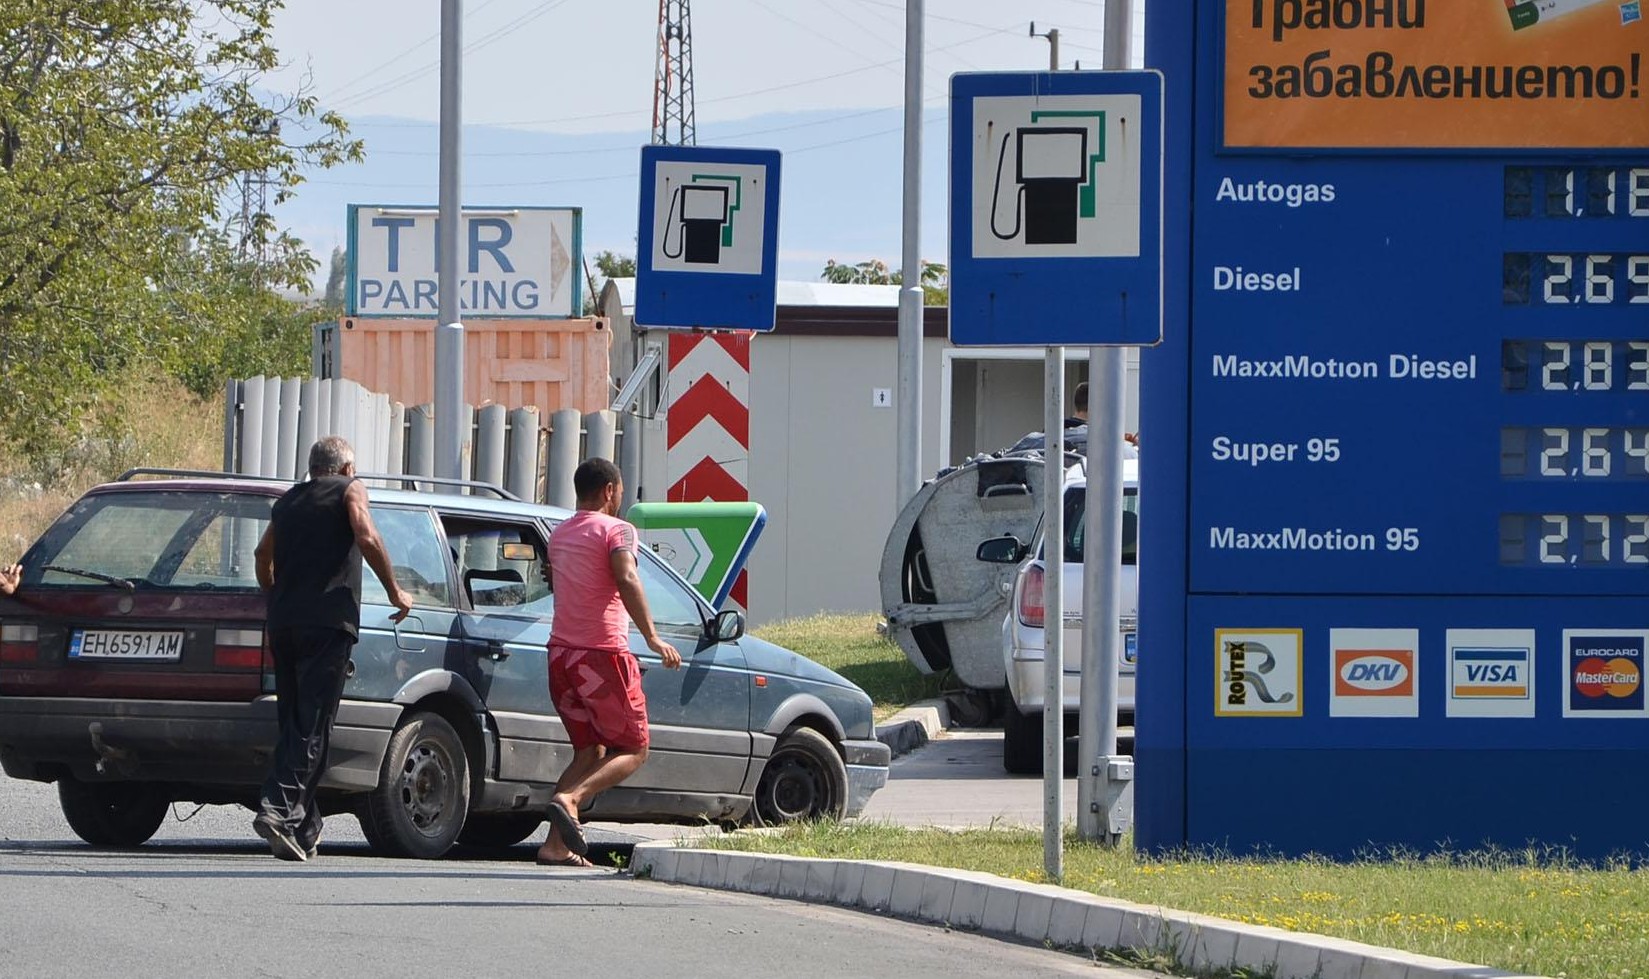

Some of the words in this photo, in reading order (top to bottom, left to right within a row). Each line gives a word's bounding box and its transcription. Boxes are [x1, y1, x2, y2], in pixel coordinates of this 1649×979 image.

[1248, 49, 1640, 99] забавлението!
[1216, 178, 1336, 207] Autogas
[1213, 267, 1300, 291] Diesel
[1389, 354, 1477, 379] Diesel
[1542, 342, 1649, 390] 2,83
[1212, 437, 1298, 466] Super
[1306, 438, 1341, 462] 95
[1540, 428, 1649, 476] 2,64
[1209, 527, 1376, 551] MaxxMotion
[1385, 528, 1420, 551] 95
[1540, 515, 1649, 563] 2,72
[1228, 641, 1246, 705] ROUTEX
[1347, 664, 1402, 681] DKV
[1465, 664, 1519, 682] VISA
[1575, 672, 1638, 684] MasterCard
